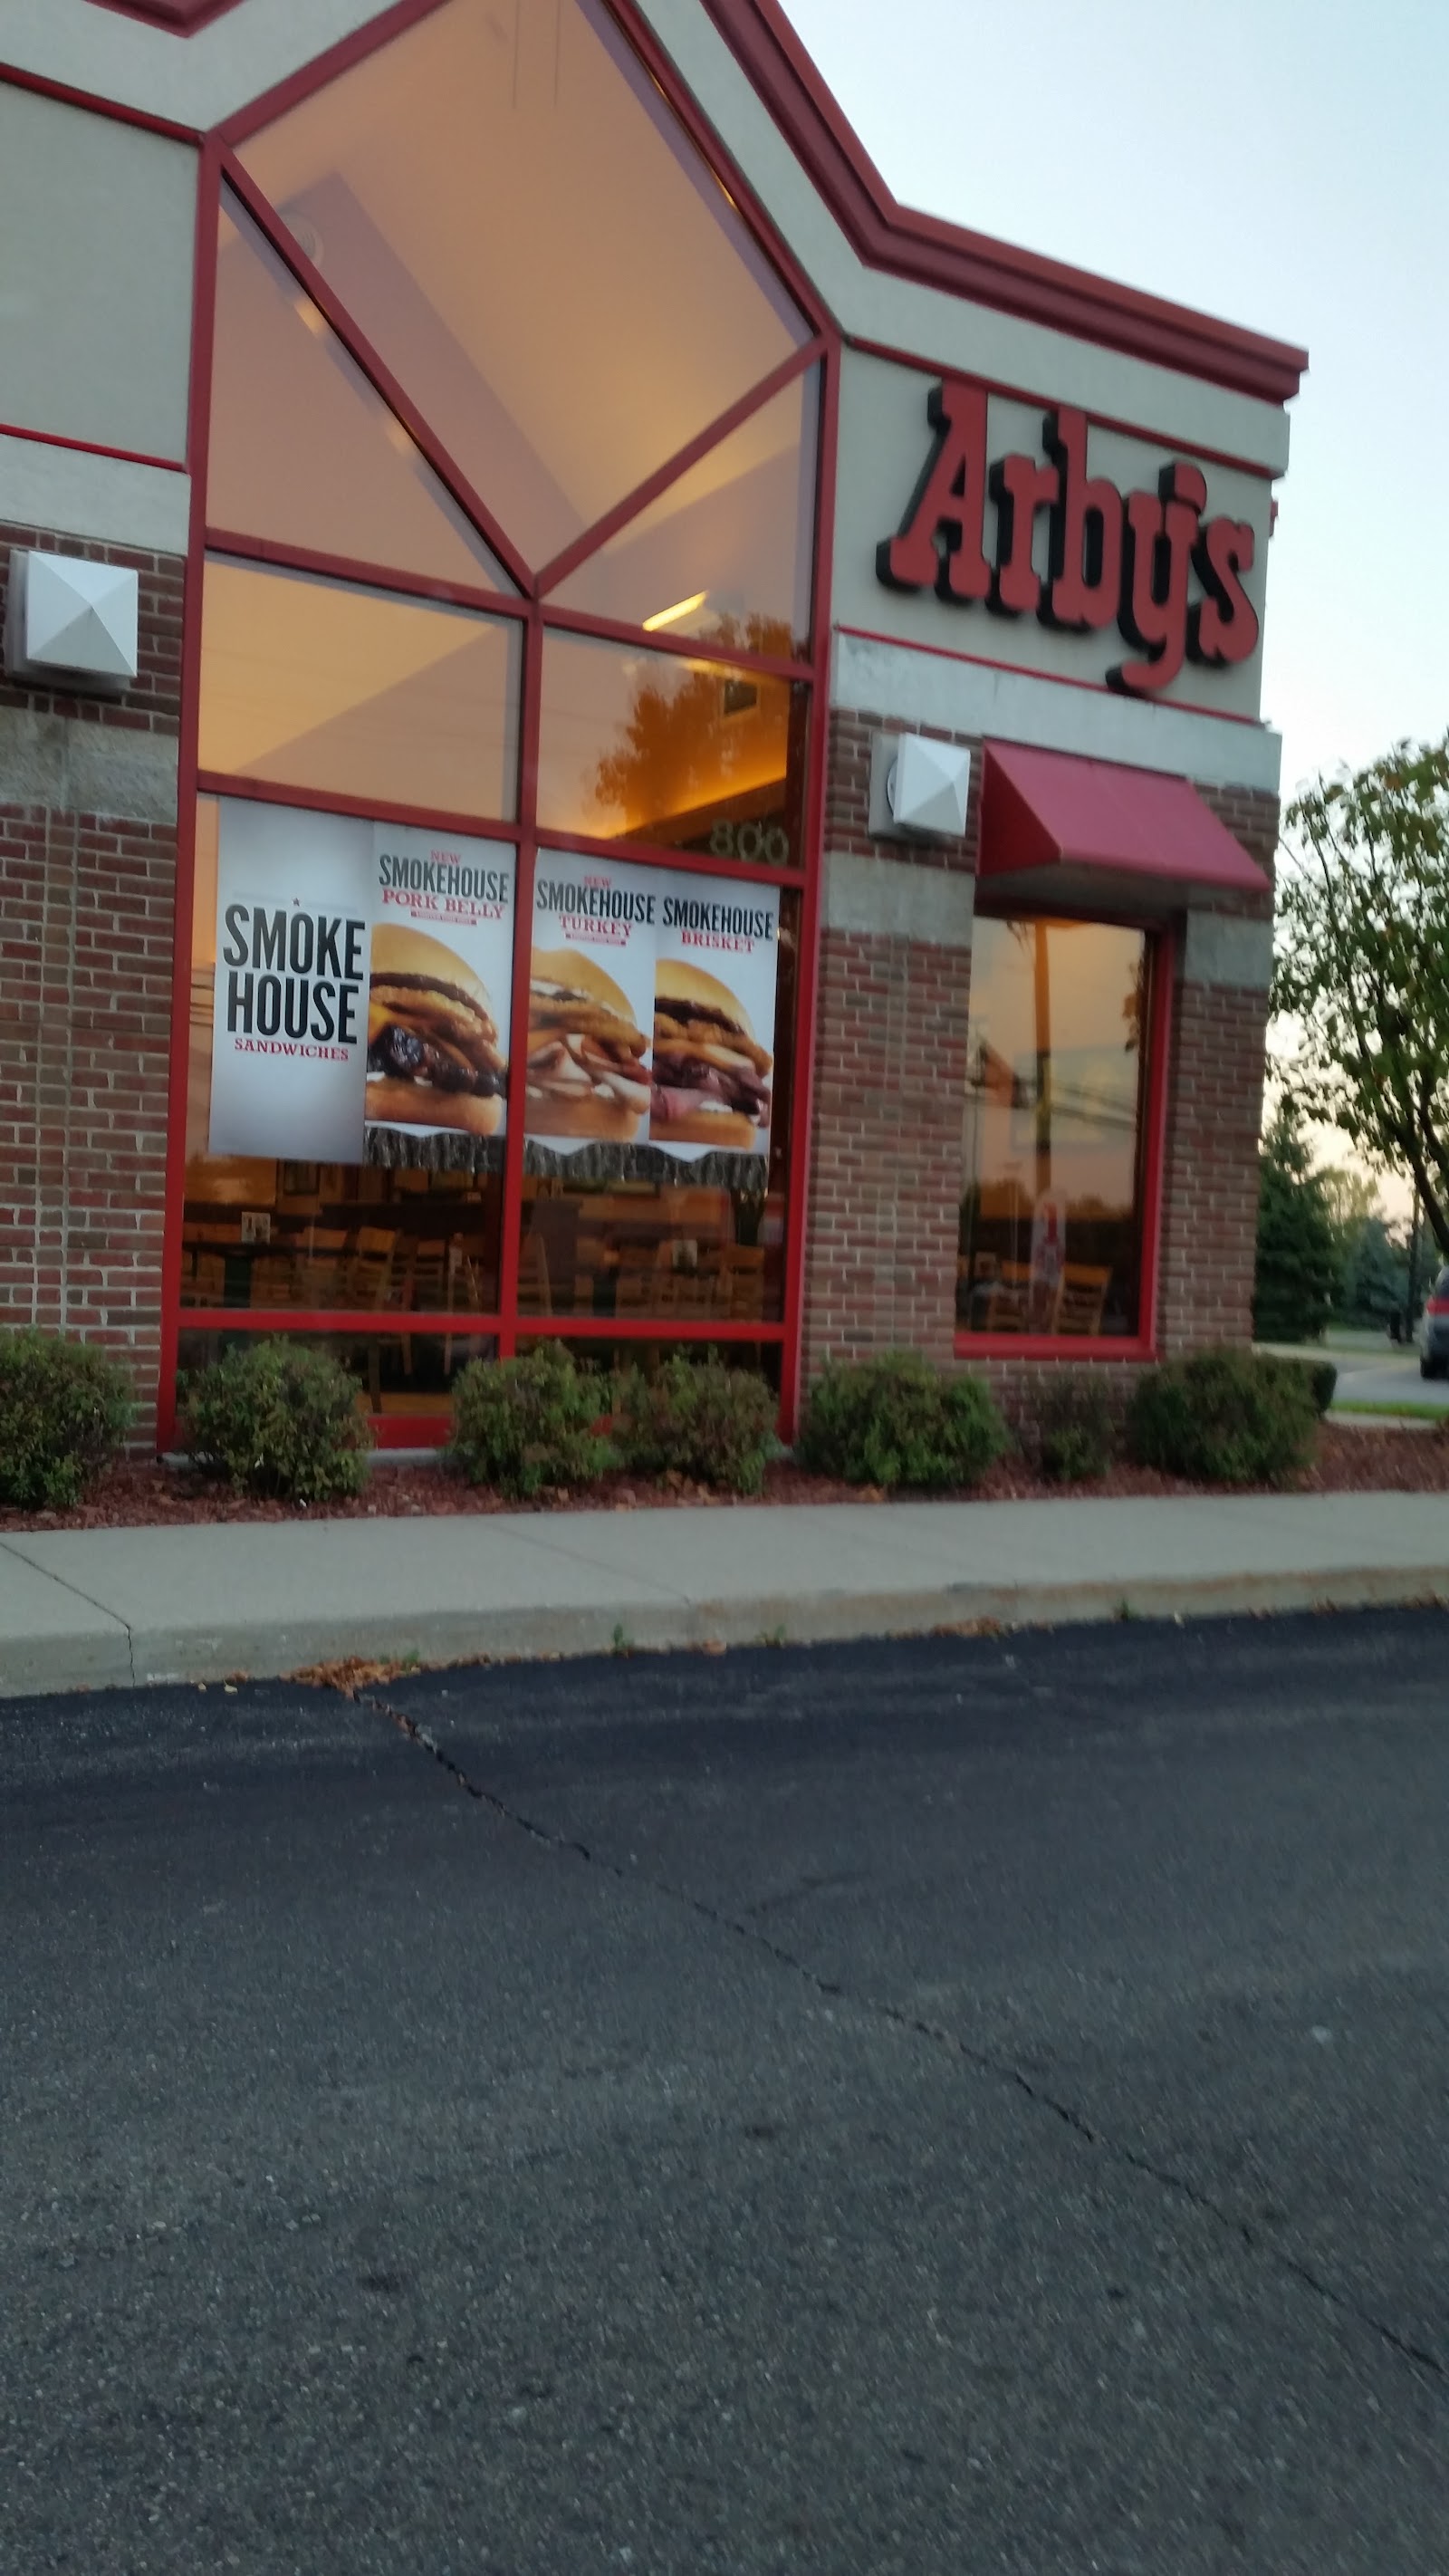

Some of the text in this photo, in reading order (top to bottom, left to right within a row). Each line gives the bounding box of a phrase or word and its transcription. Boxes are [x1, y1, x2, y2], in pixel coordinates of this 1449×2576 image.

[877, 376, 1259, 697] Arby's
[430, 850, 461, 865] NEW
[710, 819, 790, 867] 800
[379, 854, 509, 904] SMOKEHOUSE
[536, 878, 656, 925] SMOKEHOUSE
[583, 875, 611, 888] NEW
[382, 889, 438, 910] PORK
[445, 899, 504, 919] BELLY
[559, 914, 632, 937] TURKEY
[662, 896, 774, 941] SMOKEHOUSE
[223, 903, 365, 981] SMOKE
[681, 930, 754, 953] BRISKET
[227, 970, 359, 1044] HOUSE
[234, 1038, 349, 1061] SANDWICHES
